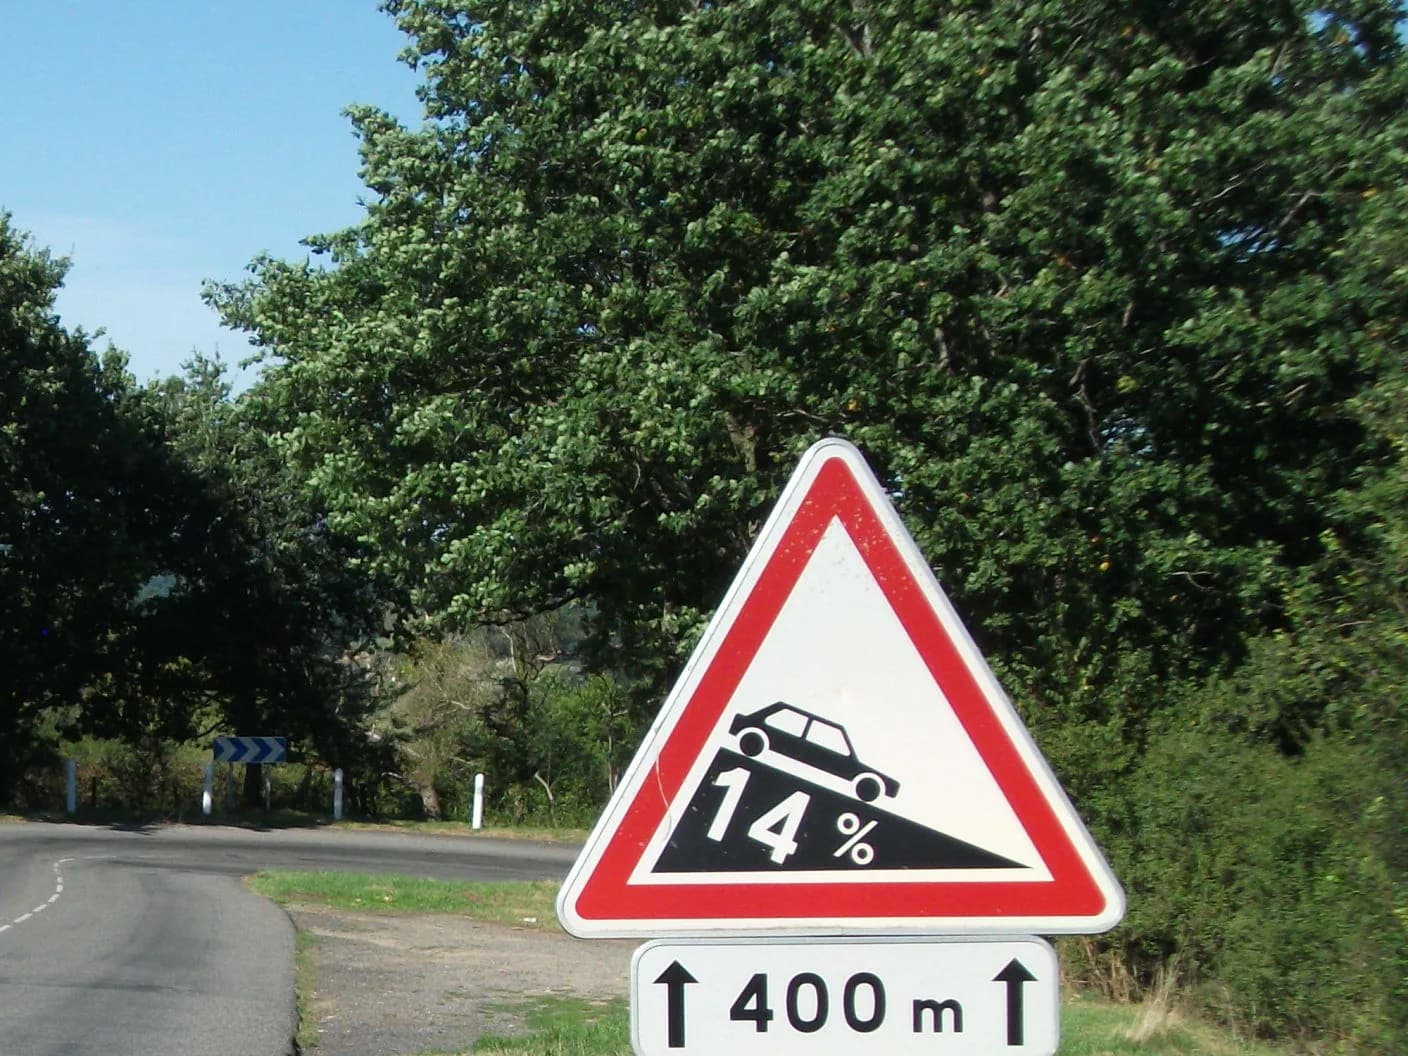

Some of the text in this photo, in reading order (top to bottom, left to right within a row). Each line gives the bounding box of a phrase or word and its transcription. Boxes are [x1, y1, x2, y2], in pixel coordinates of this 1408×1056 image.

[707, 767, 811, 865] 14
[729, 972, 964, 1034] 400 m
